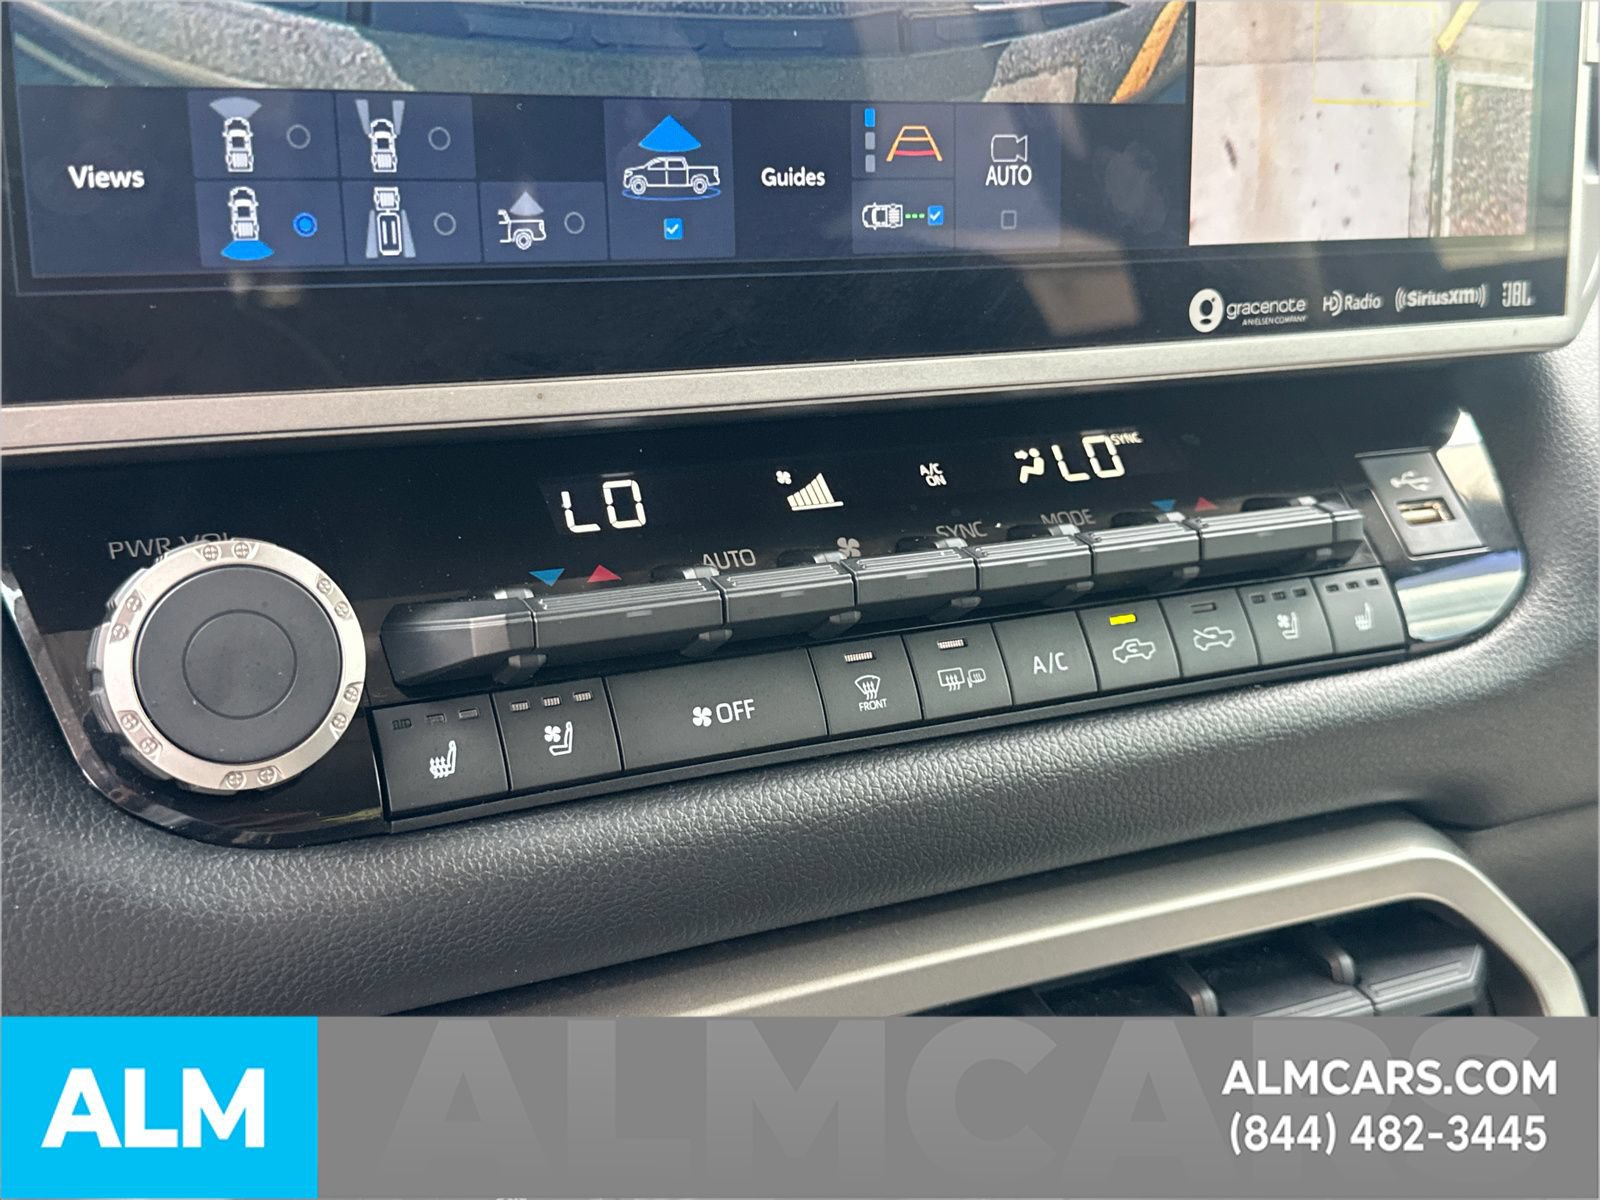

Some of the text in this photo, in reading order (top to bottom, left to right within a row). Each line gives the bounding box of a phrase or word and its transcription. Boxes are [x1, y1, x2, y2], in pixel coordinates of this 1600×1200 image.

[68, 164, 145, 190] Views
[761, 166, 826, 188] Guides
[985, 164, 1033, 187] AUTO
[1344, 293, 1382, 311] Radio
[1502, 281, 1532, 307] JBL
[1226, 298, 1306, 320] gracenote
[1110, 431, 1144, 446] SYNC
[920, 462, 943, 476] A/C
[925, 474, 947, 487] ON
[1040, 508, 1096, 526] MODE
[935, 521, 988, 540] SYNC
[108, 537, 171, 560] PWR
[702, 548, 757, 570] AUTO
[1032, 652, 1069, 674] A/C
[716, 698, 755, 724] OFF
[858, 698, 888, 712] FRONT
